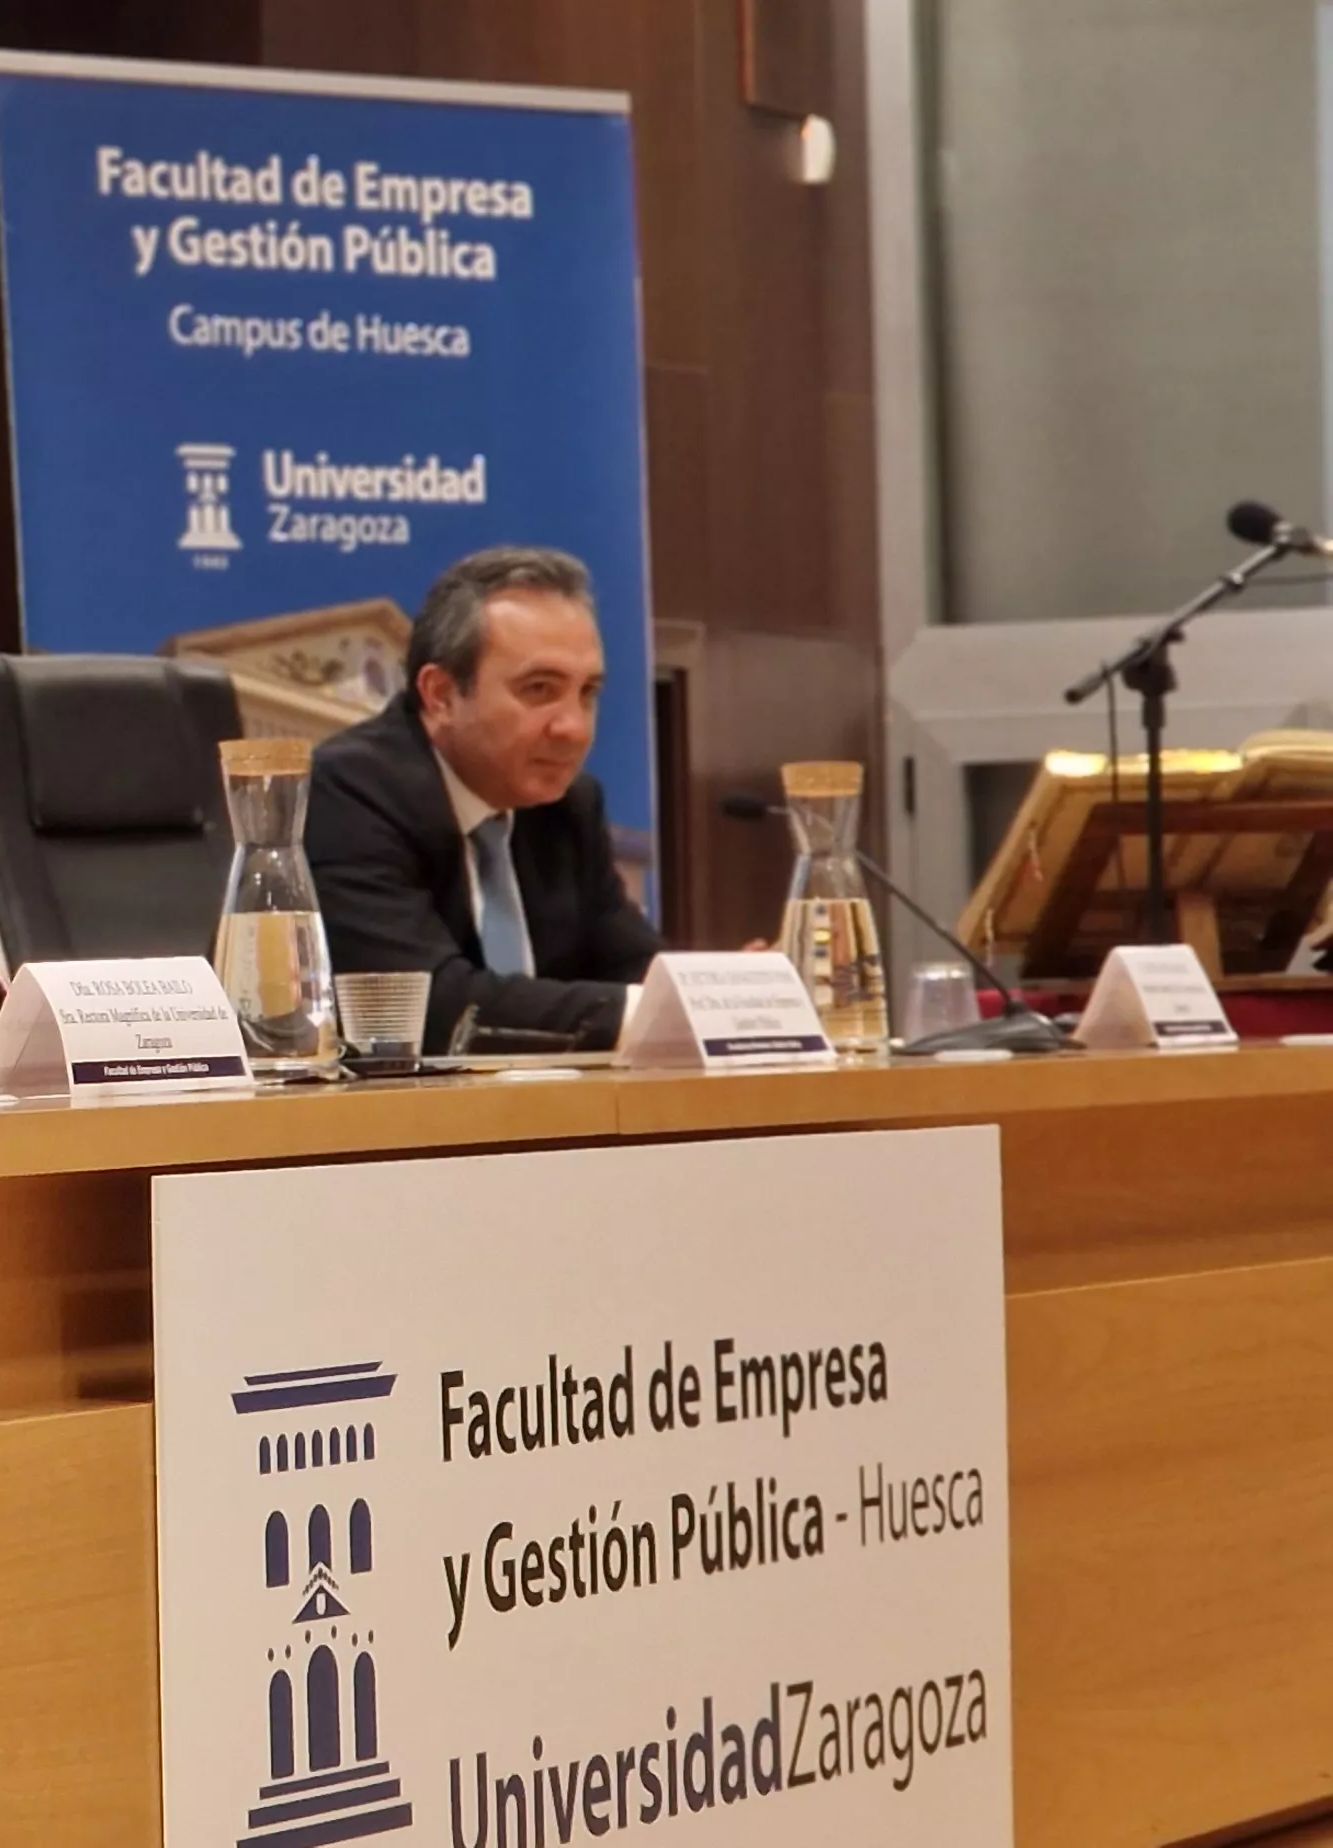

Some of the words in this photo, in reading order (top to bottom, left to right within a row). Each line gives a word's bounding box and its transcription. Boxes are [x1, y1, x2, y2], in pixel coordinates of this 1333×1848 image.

[96, 146, 282, 202] Facultad
[292, 154, 345, 209] de
[354, 162, 533, 225] Empresa
[132, 225, 159, 276] y
[168, 216, 333, 271] Gestión
[343, 224, 498, 280] Pública
[168, 304, 302, 358] Campus
[308, 312, 350, 352] de
[357, 314, 471, 357] Huesca
[262, 449, 487, 503] Universidad
[267, 503, 411, 552] Zaragoza
[93, 980, 122, 996] ROSA
[439, 1344, 635, 1463] Facultad
[648, 1340, 701, 1433] de
[713, 1337, 889, 1438] Empresa
[442, 1552, 471, 1652] y
[483, 1499, 658, 1614] Gestión
[671, 1476, 825, 1582] Pública
[835, 1511, 848, 1524] -
[857, 1461, 984, 1547] Huesca
